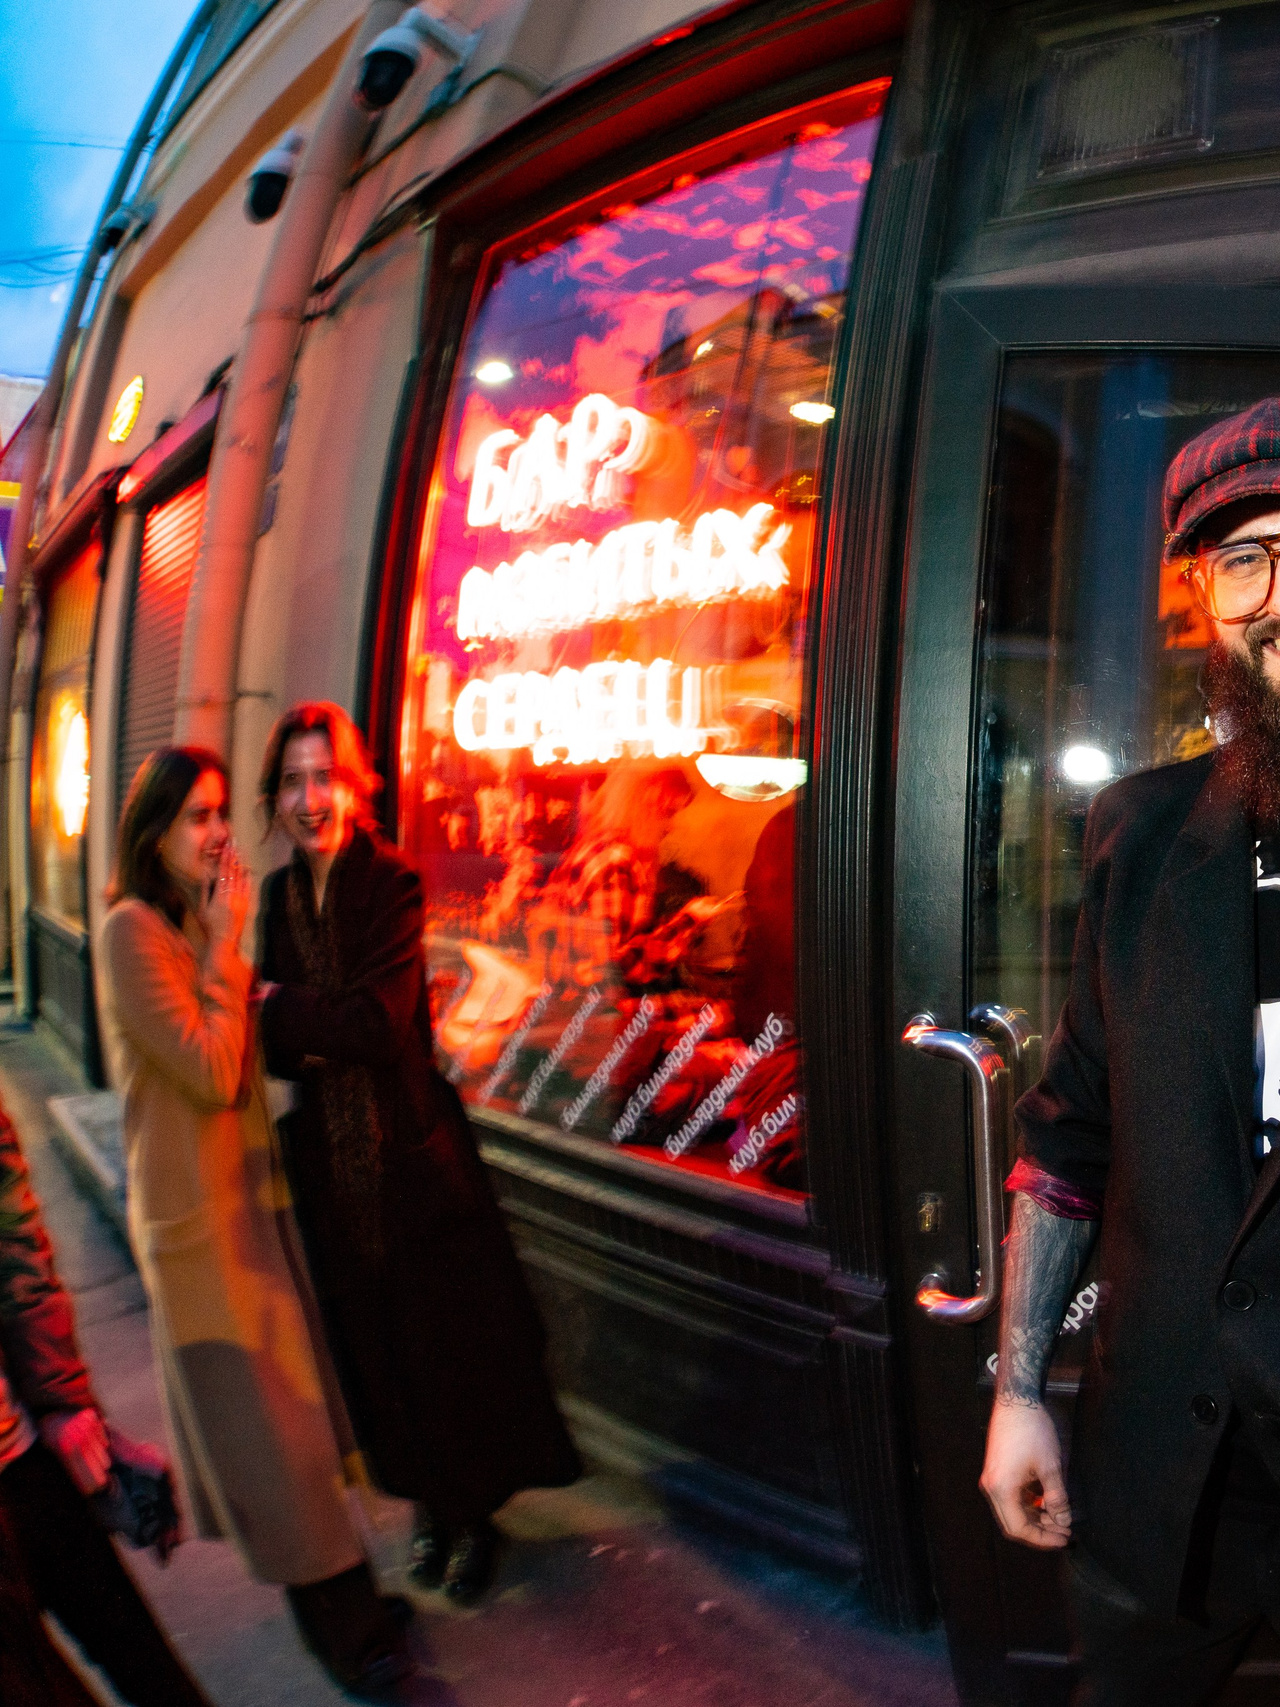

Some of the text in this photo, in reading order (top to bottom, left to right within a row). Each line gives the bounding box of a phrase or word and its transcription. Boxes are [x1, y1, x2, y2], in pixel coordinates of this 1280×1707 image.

[623, 993, 655, 1043] клуб
[611, 1002, 717, 1141] клуб бильярдный
[665, 1012, 784, 1156] бильярдный клуб
[728, 1125, 766, 1174] клуб
